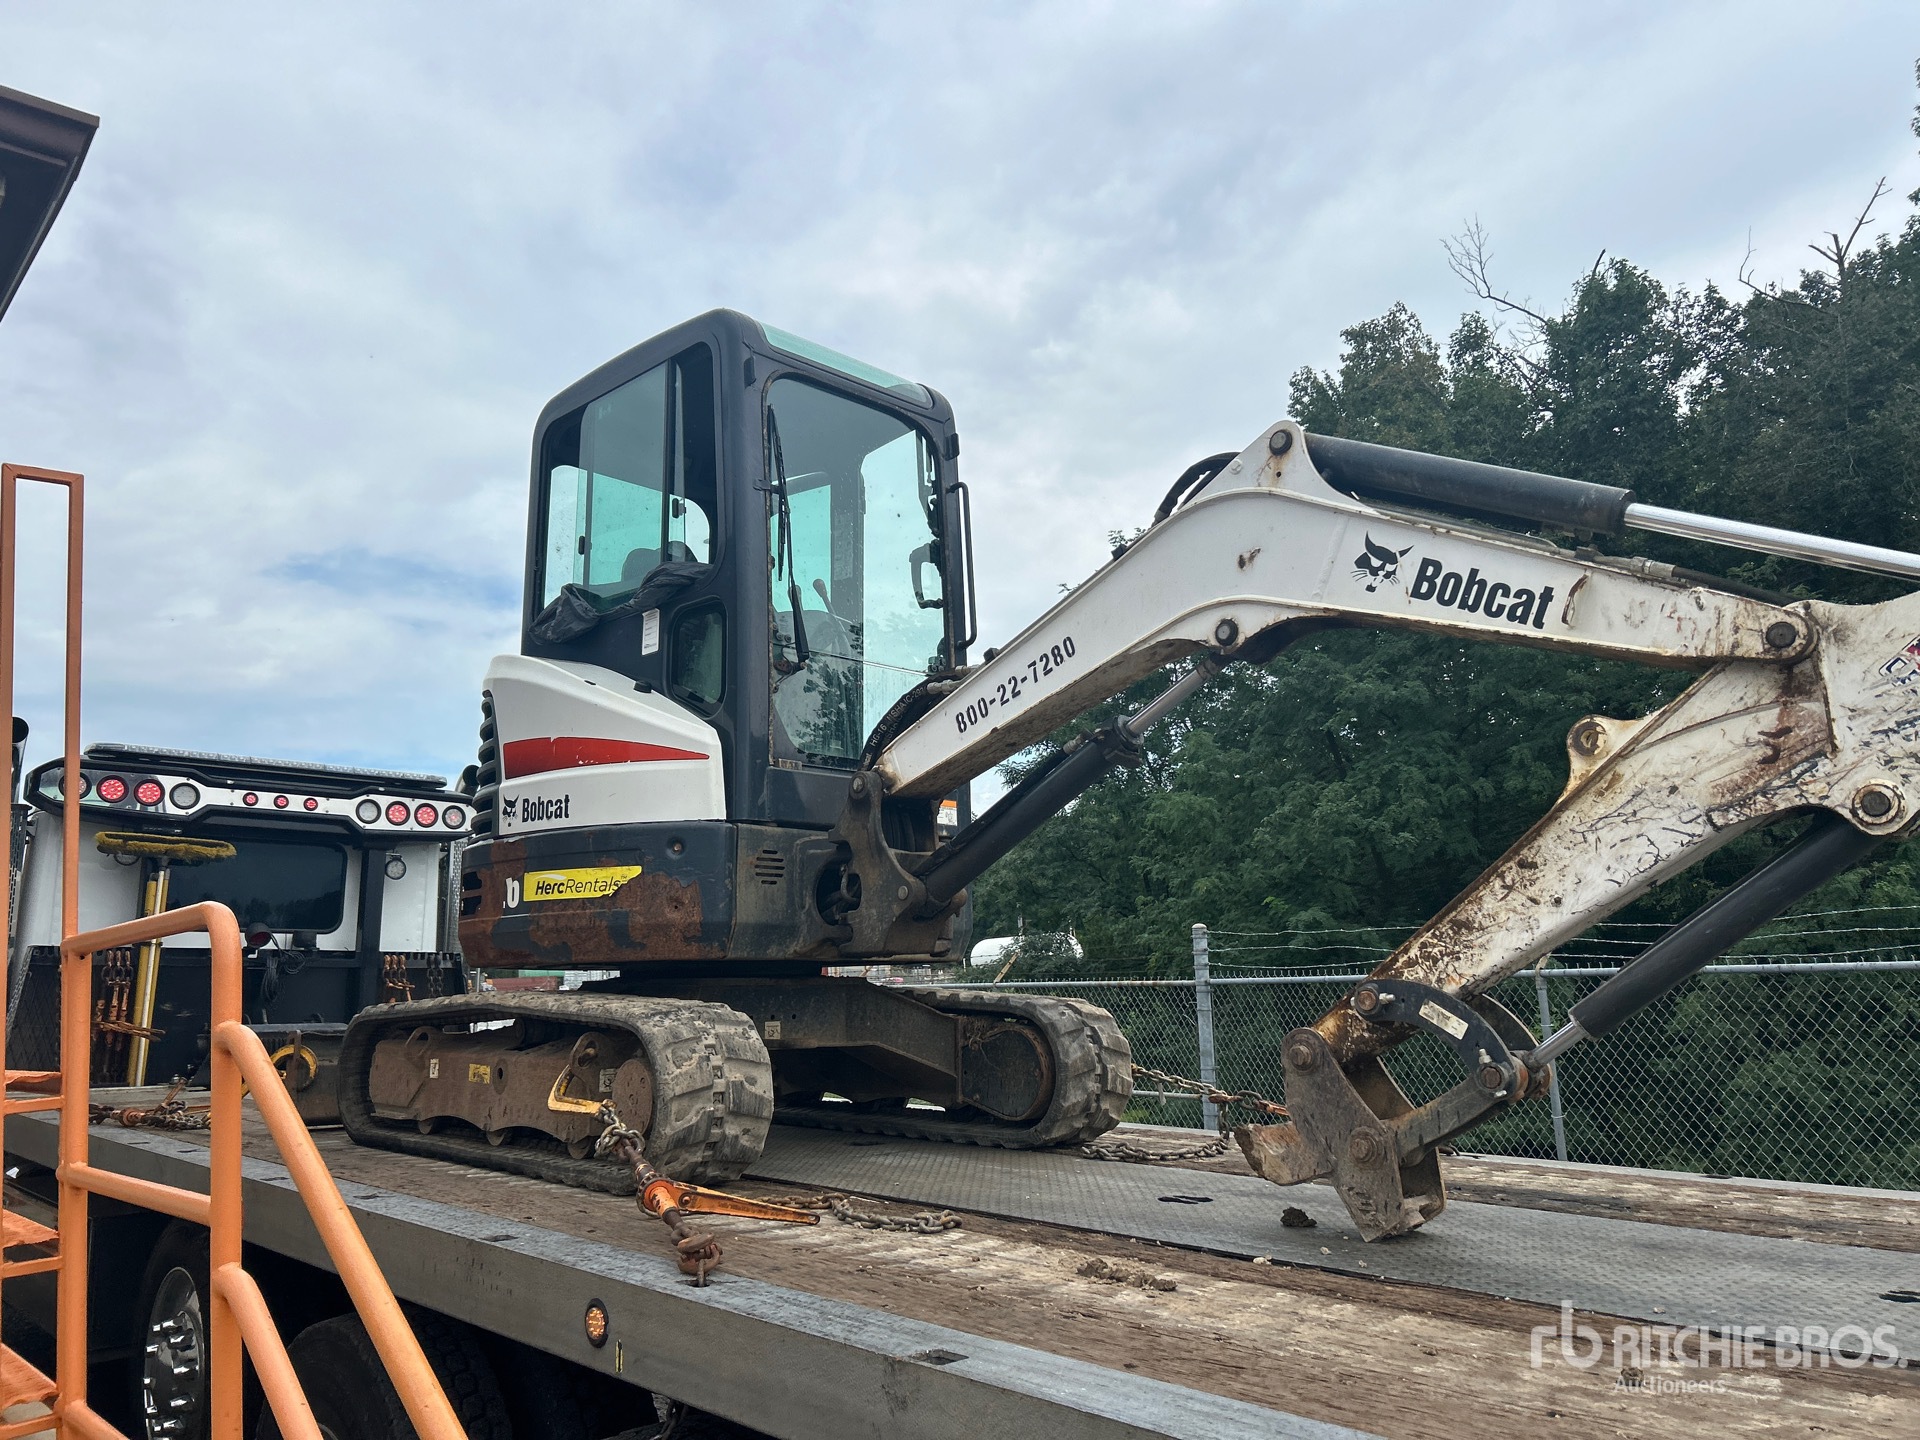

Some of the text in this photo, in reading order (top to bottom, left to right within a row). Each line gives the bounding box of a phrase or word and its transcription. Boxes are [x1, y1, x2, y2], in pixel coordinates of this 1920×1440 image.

[1409, 556, 1555, 630] Bobcat
[955, 636, 1076, 733] 800-22-7280
[521, 794, 570, 823] Bobcat
